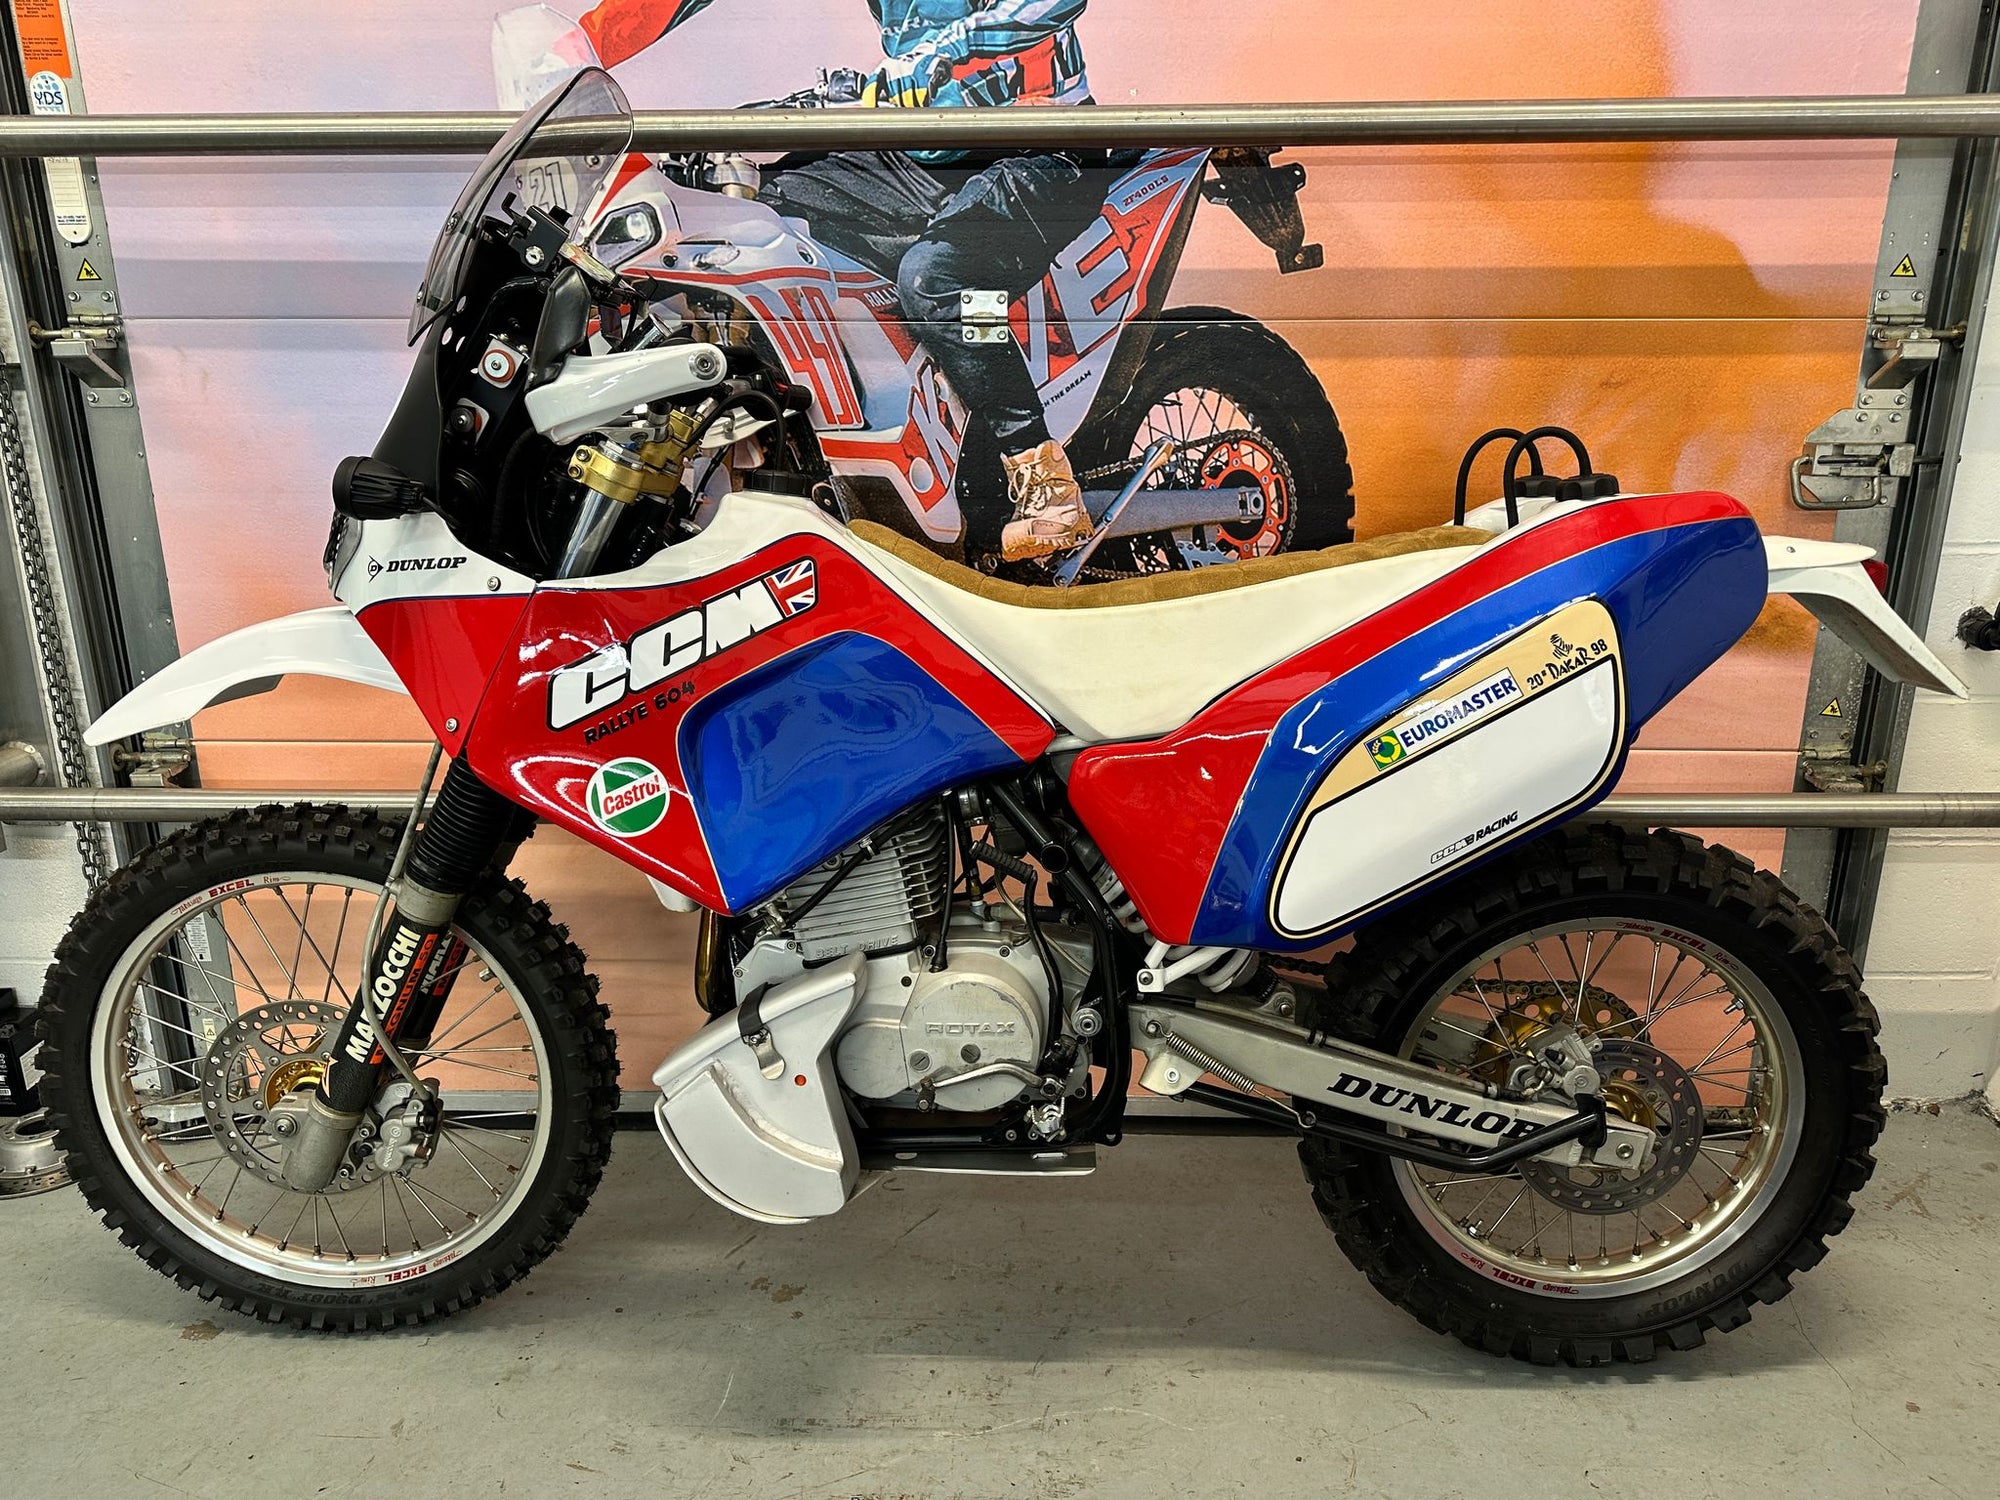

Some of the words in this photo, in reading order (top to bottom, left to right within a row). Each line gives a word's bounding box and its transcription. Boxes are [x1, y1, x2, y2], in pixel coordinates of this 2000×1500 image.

[33, 91, 64, 105] YDS
[1050, 389, 1065, 403] THE
[1065, 369, 1092, 393] DREAM
[386, 556, 467, 573] DUNLOP
[549, 578, 785, 731] CCM
[1546, 647, 1596, 680] DAKAR
[1590, 638, 1608, 655] 98
[584, 701, 649, 745] RALLYE
[653, 680, 695, 711] 604
[1400, 677, 1518, 748] EUROMASTER
[603, 774, 661, 815] Castrol
[1476, 810, 1519, 841] RACING
[208, 879, 254, 898] EXCEL
[419, 938, 434, 961] 50
[816, 944, 848, 958] BELT
[858, 934, 899, 951] DRIVE
[1660, 928, 1706, 953] EXCEL
[345, 925, 422, 1064] MARZOCCHI
[925, 1021, 1015, 1035] ROTAX
[1326, 1072, 1546, 1139] DUNLOP
[384, 1264, 428, 1282] EXCEL
[1491, 1267, 1537, 1289] EXCEL
